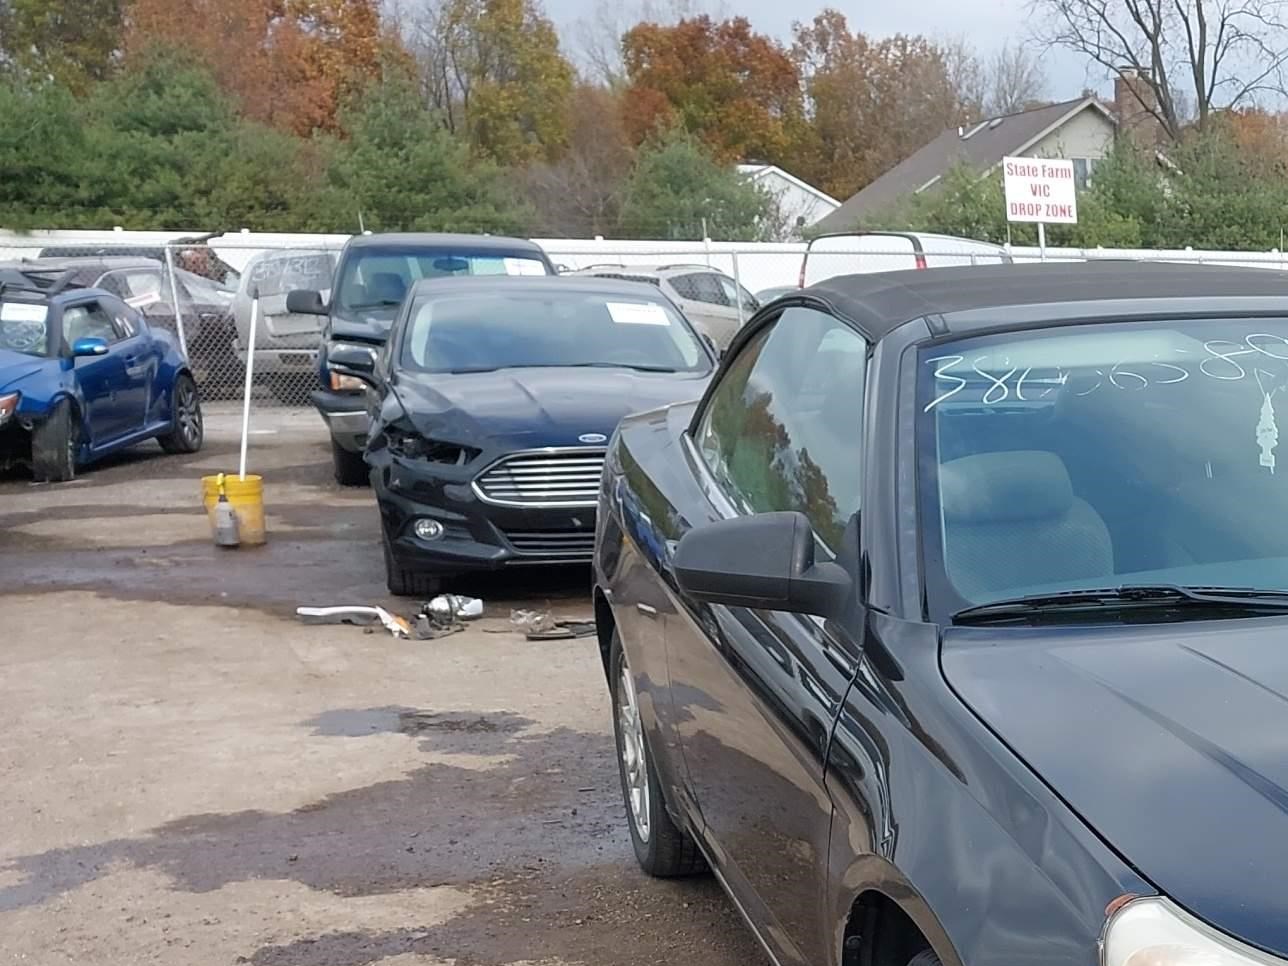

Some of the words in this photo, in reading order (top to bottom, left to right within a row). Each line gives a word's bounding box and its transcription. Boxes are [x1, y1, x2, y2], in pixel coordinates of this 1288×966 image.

[1006, 162, 1038, 178] State
[1041, 164, 1072, 179] Farm
[1030, 183, 1051, 198] VIC
[1010, 202, 1042, 217] DROP
[1045, 203, 1073, 218] ZONE
